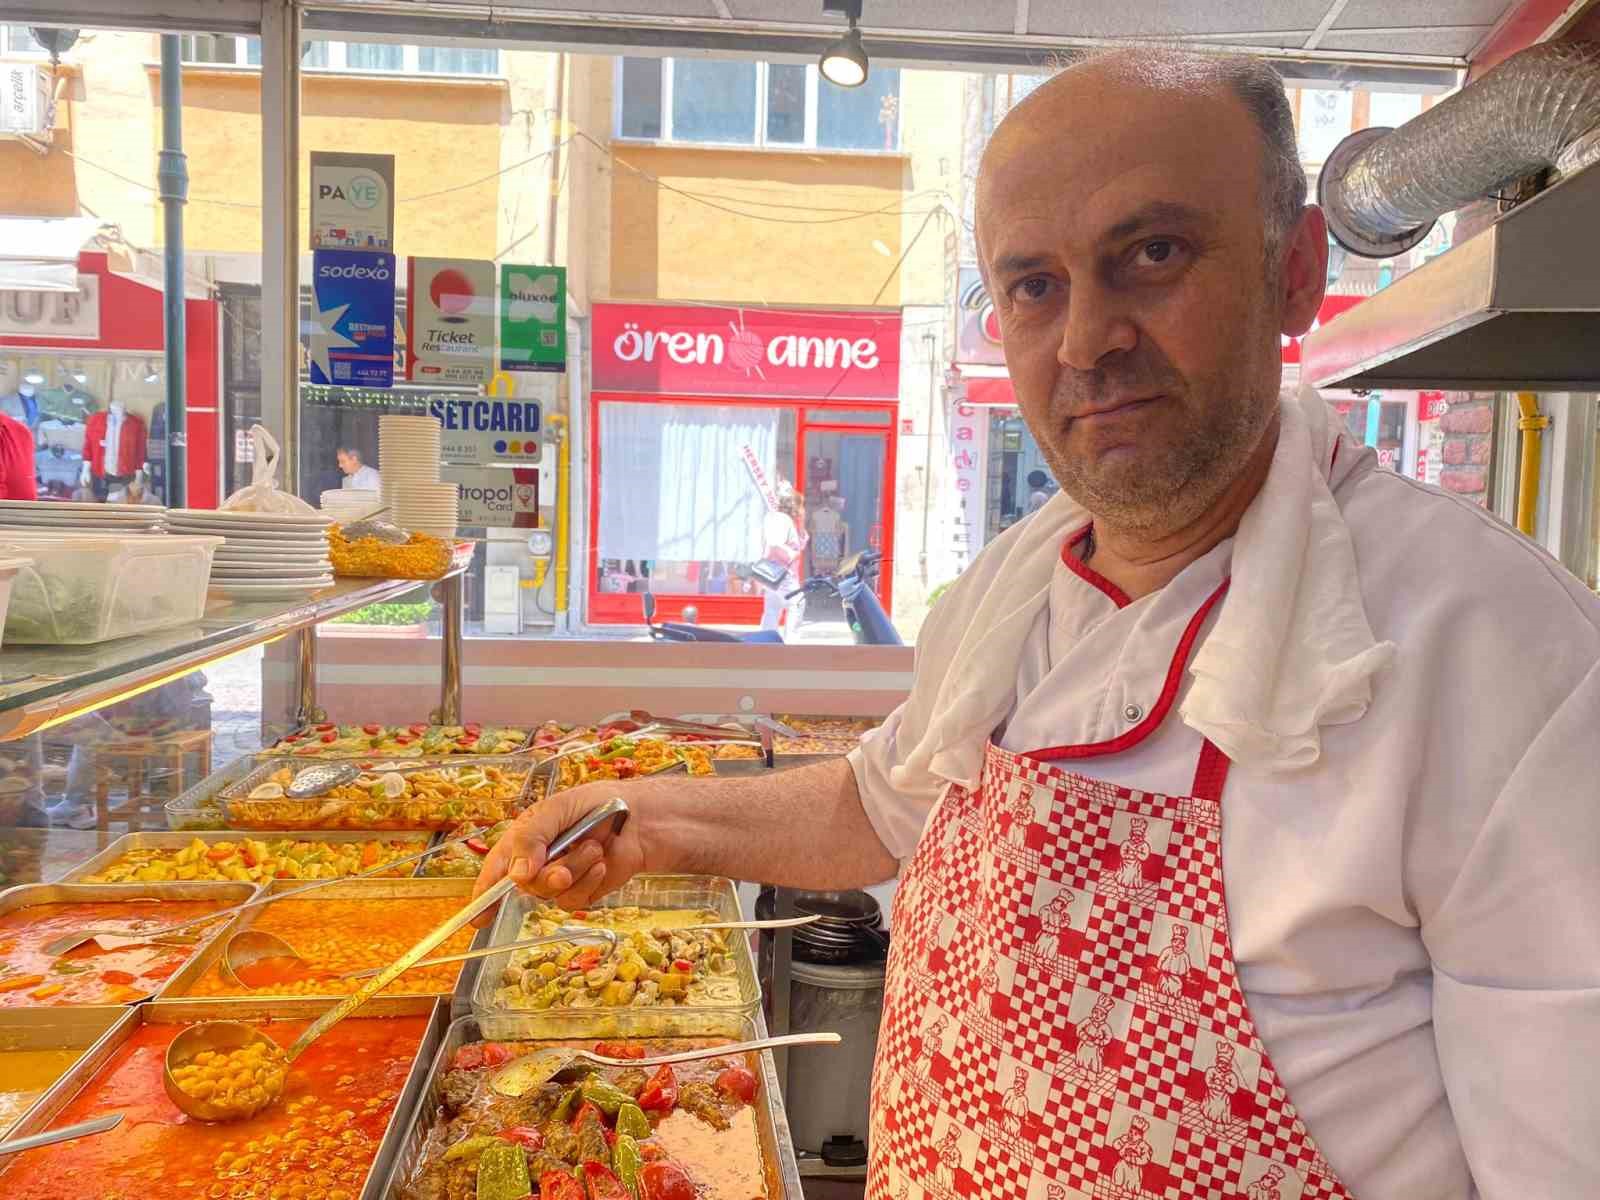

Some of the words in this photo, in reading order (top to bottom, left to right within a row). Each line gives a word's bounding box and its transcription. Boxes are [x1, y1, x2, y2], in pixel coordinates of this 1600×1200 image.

[319, 262, 390, 280] sodexo
[426, 328, 475, 344] Ticket
[613, 322, 725, 365] ören
[767, 334, 880, 370] anne
[428, 398, 541, 433] SETCARD
[487, 500, 513, 512] Card
